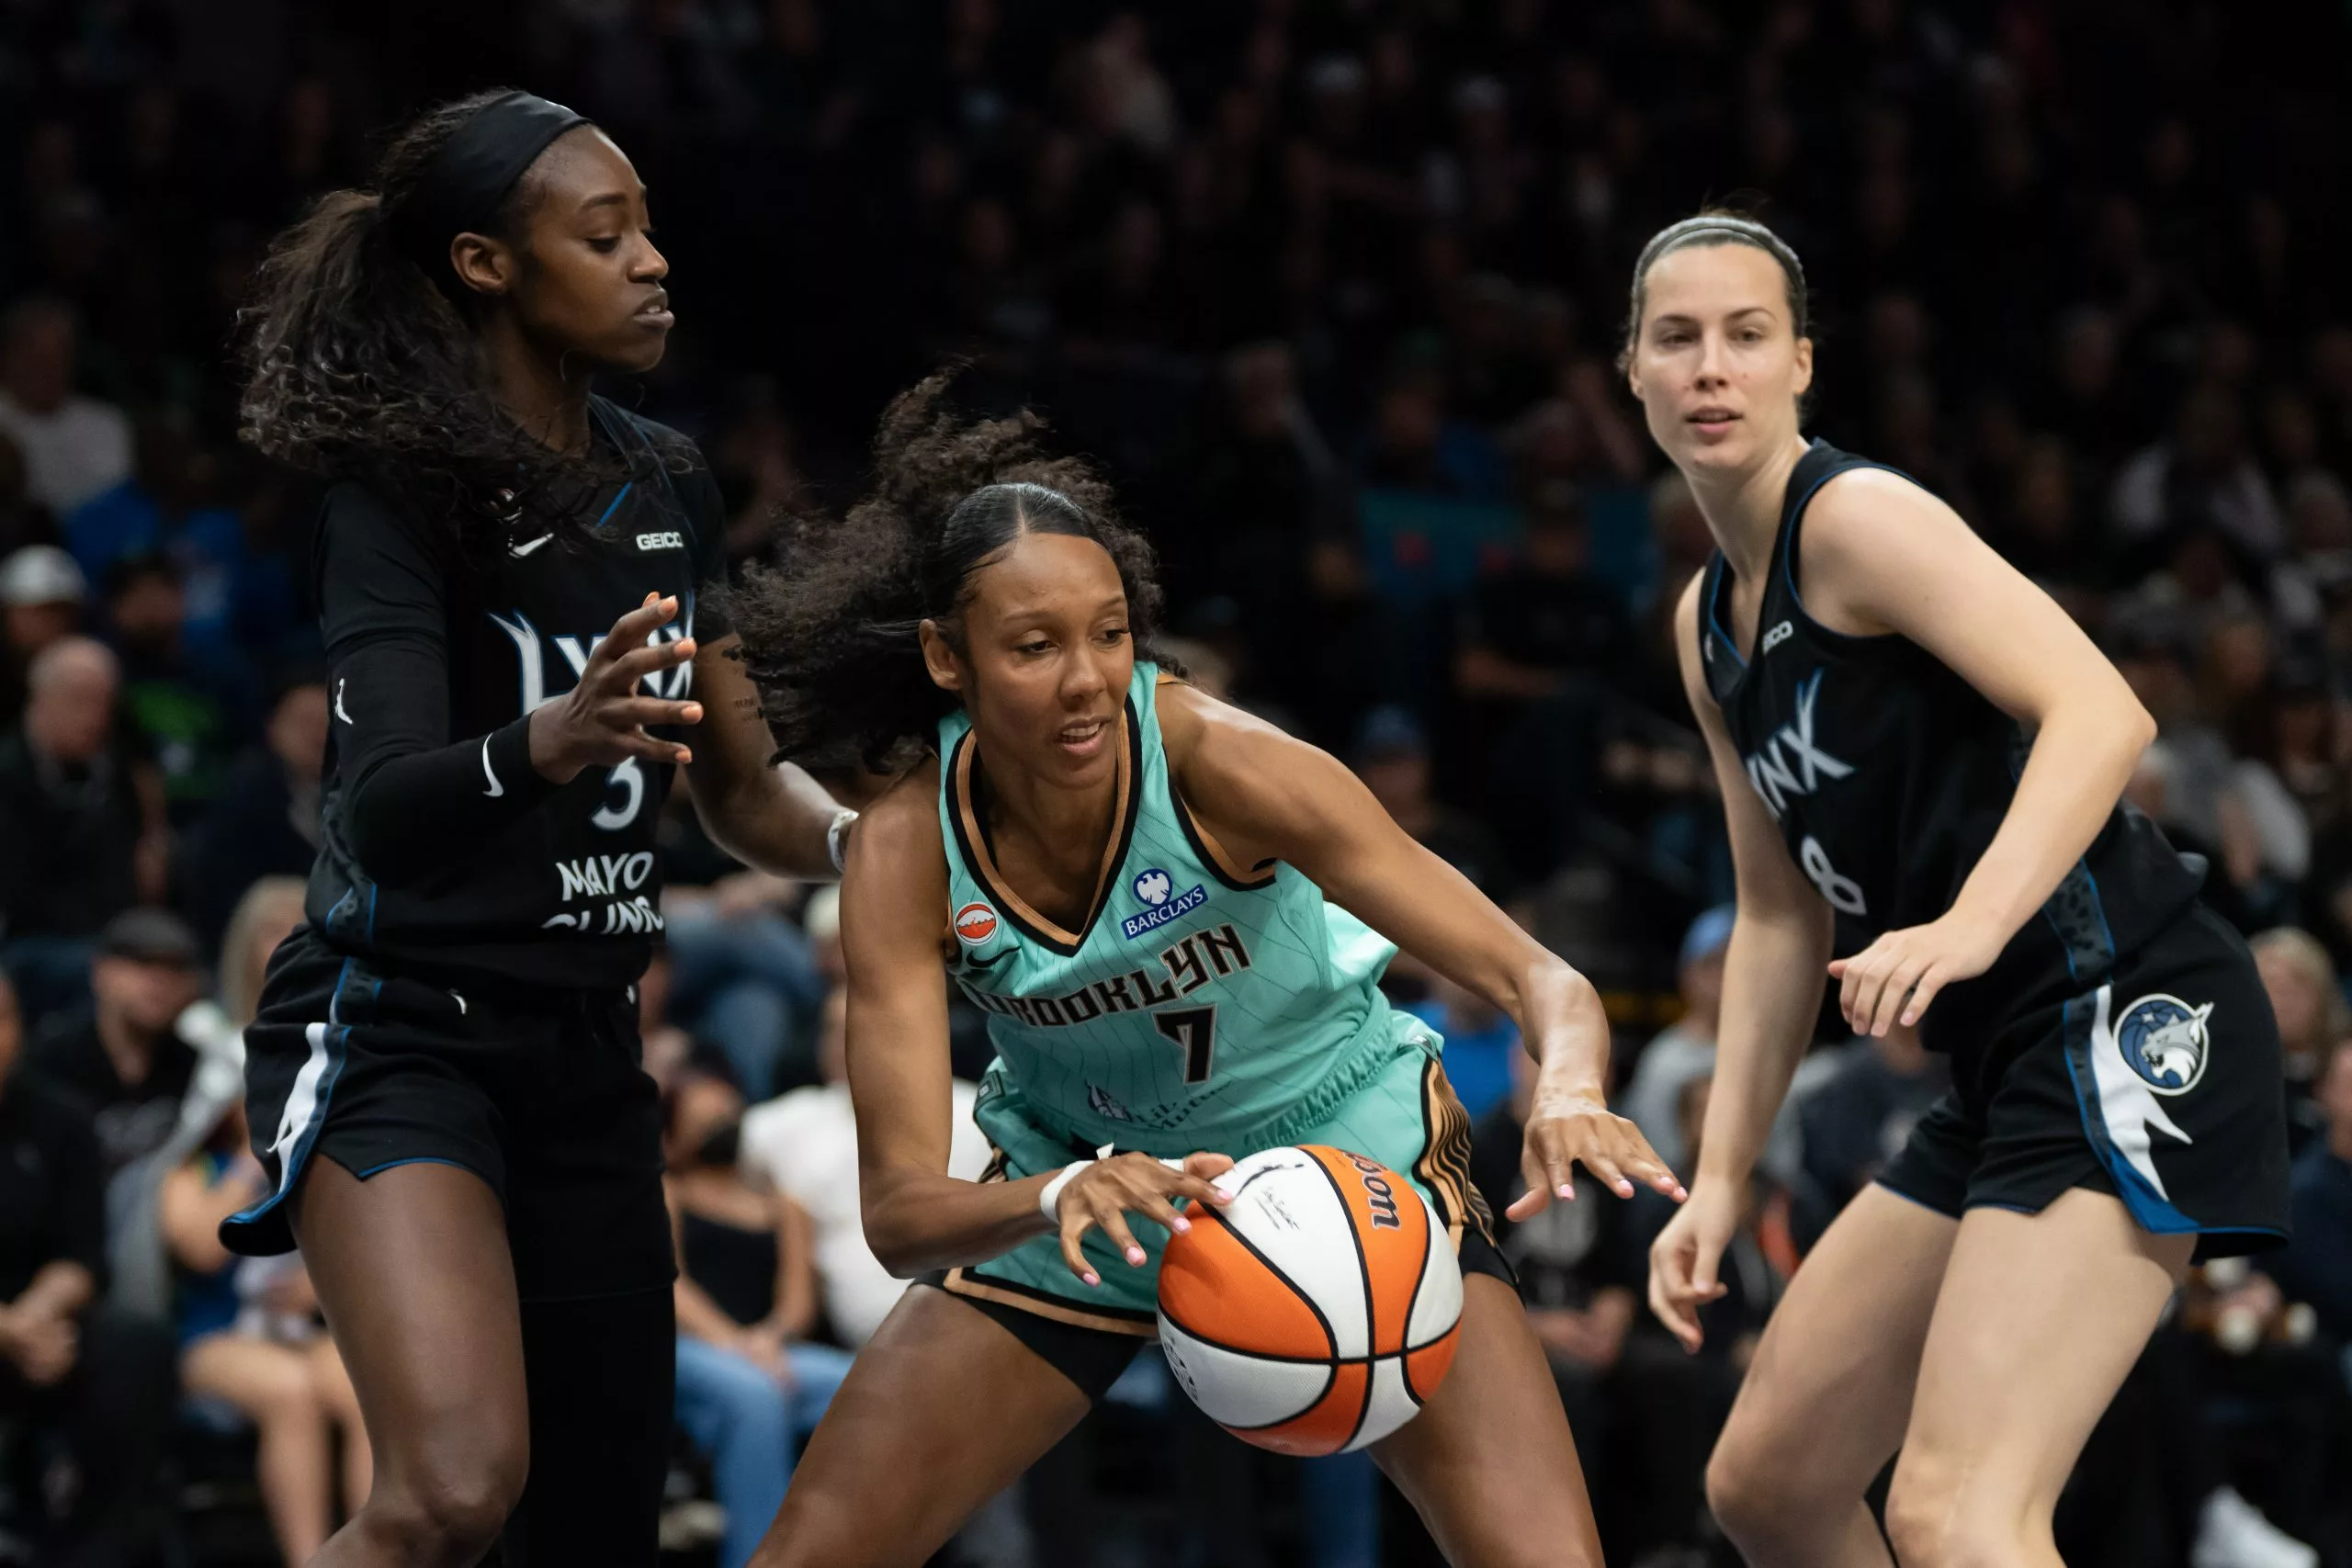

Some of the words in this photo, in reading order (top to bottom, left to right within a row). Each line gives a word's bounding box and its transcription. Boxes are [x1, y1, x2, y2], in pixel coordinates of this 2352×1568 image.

[555, 851, 655, 902] MAYO
[1801, 836, 1868, 916] 8
[1125, 886, 1204, 936] BARCLAYS
[1152, 1001, 1218, 1086] 7
